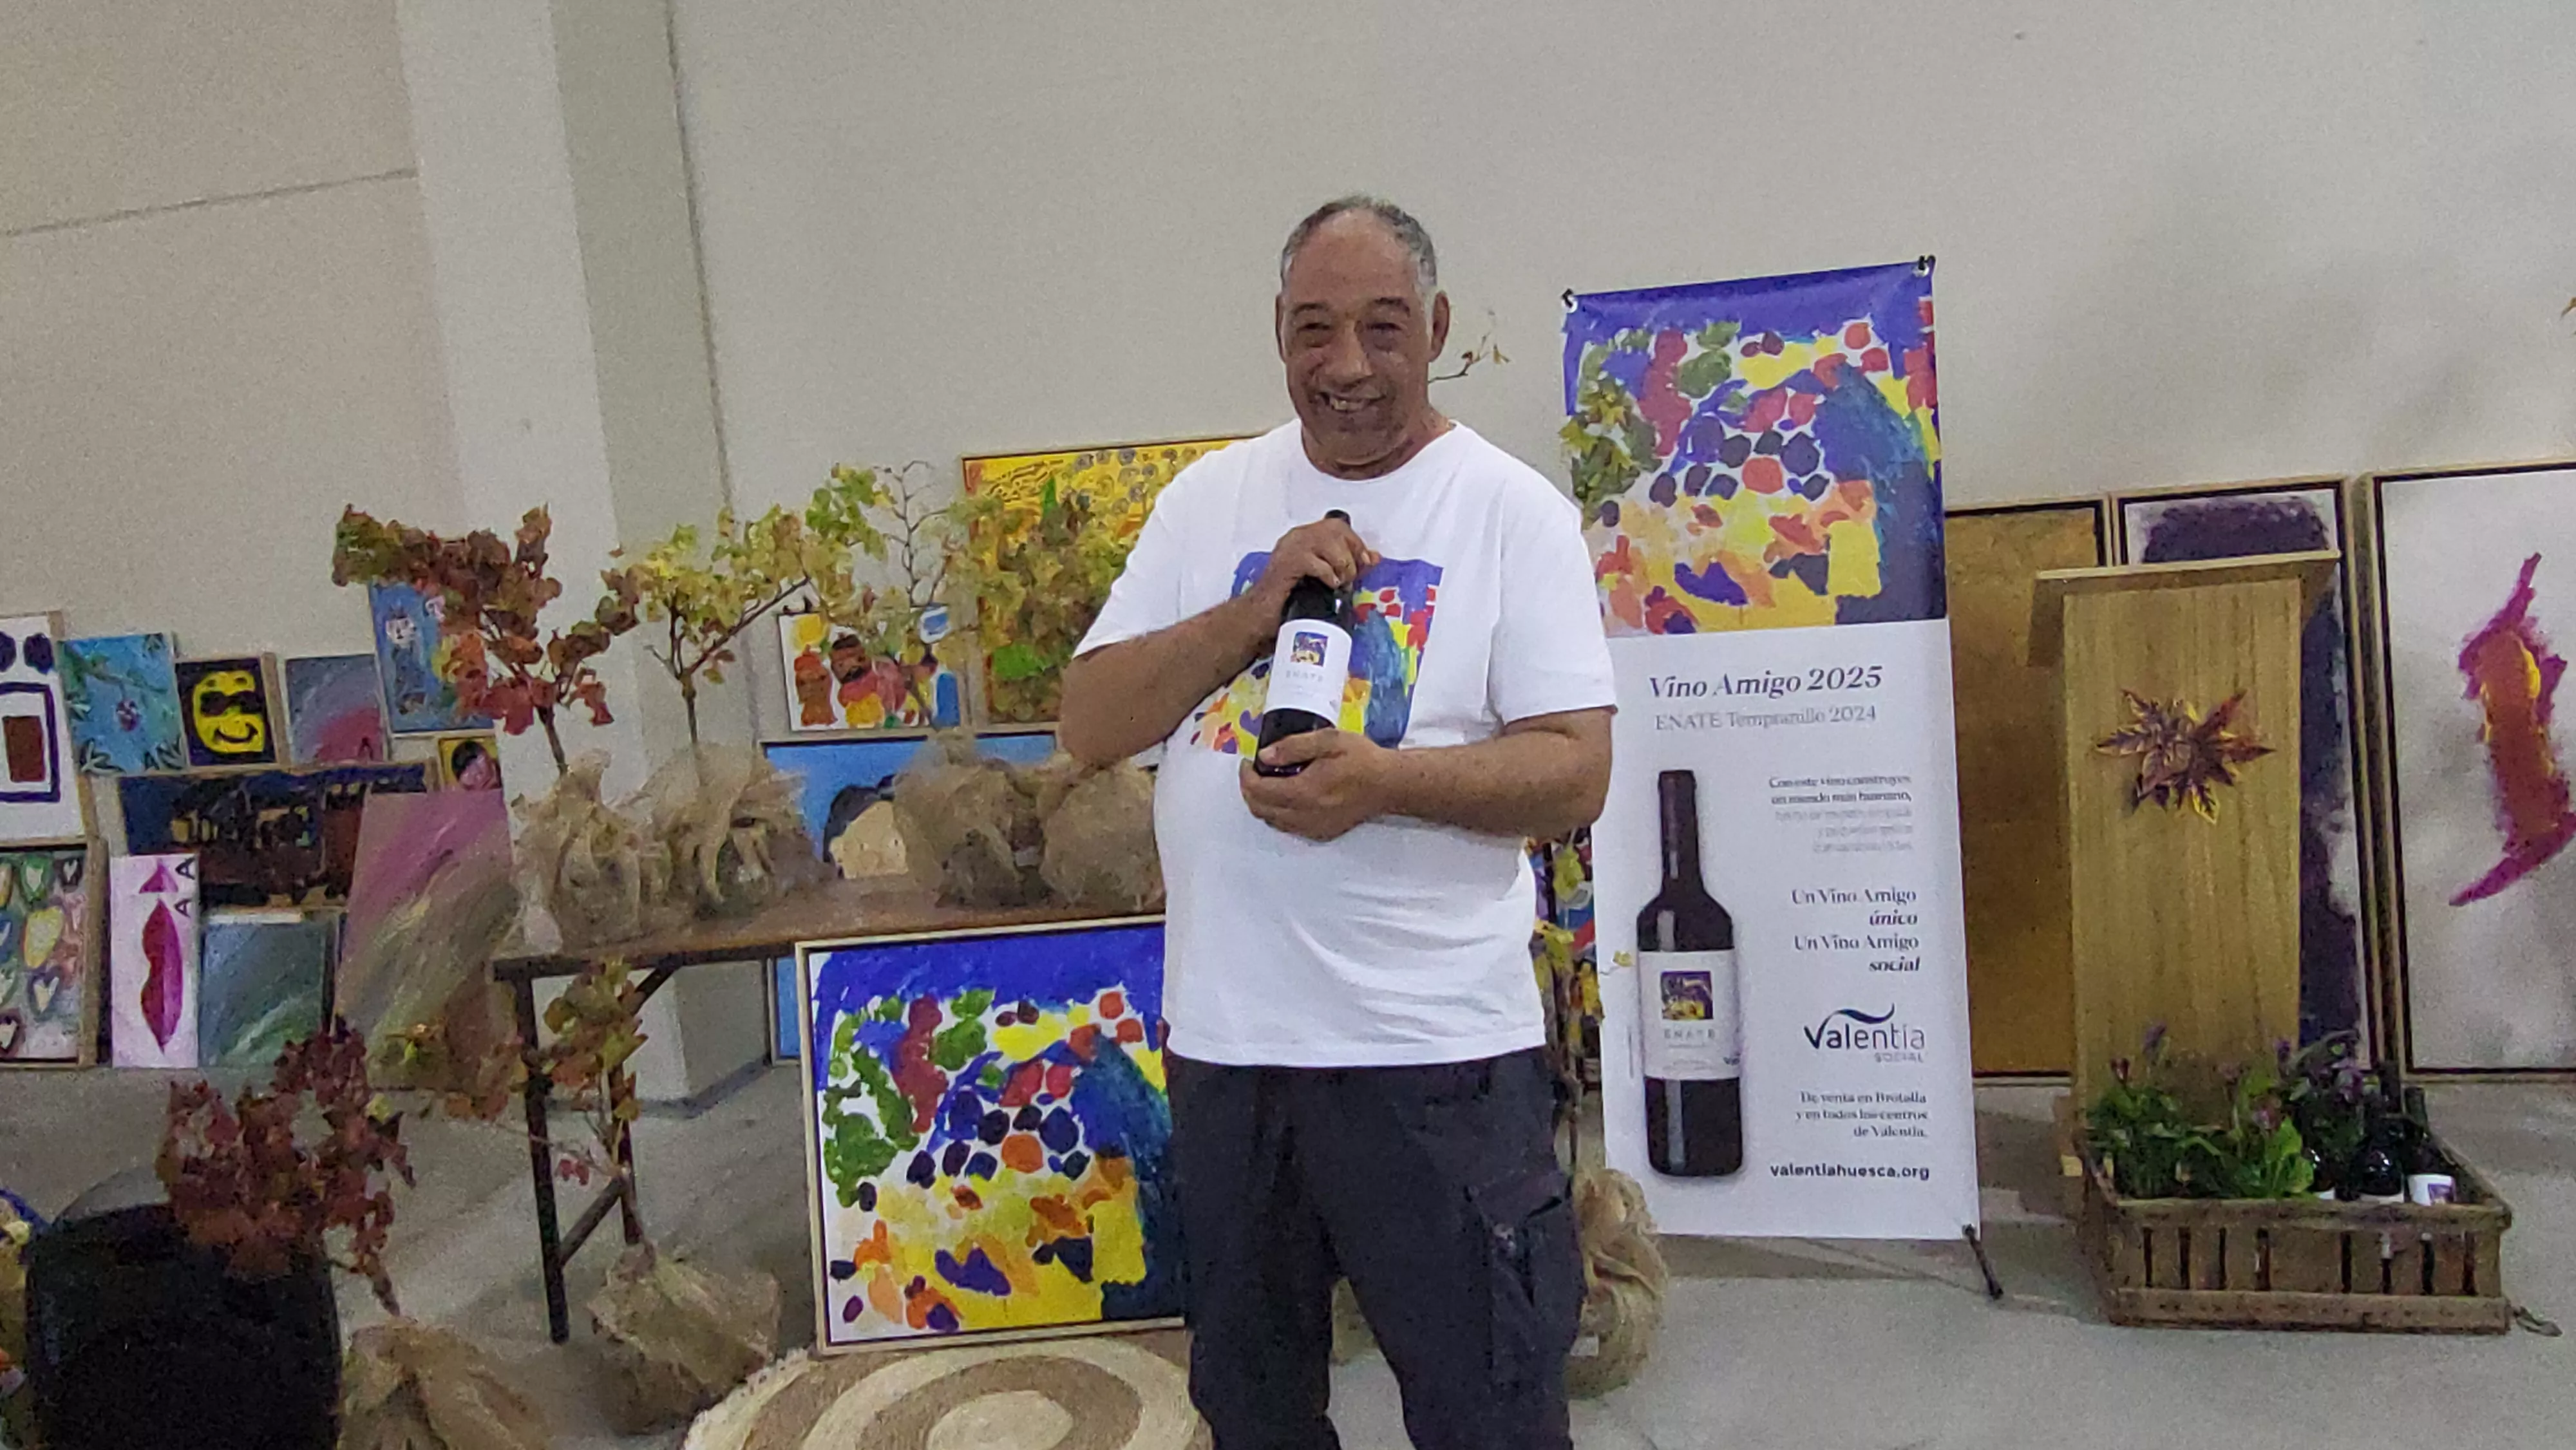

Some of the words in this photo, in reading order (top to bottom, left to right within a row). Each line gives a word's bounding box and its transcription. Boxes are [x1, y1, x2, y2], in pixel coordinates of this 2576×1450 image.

[1649, 675, 1707, 697] Vino
[1712, 670, 1801, 699] Amigo
[1807, 665, 1882, 691] 2025
[1655, 712, 1723, 731] ENATE
[1829, 705, 1877, 722] 2024
[1792, 889, 1815, 905] Un
[1818, 888, 1857, 903] Vino
[1862, 887, 1917, 905] Amigo
[1870, 909, 1918, 926] único
[1794, 935, 1818, 950] Un
[1821, 934, 1860, 950] Vino
[1864, 933, 1919, 951] Amigo
[1869, 956, 1920, 972] social
[1804, 1013, 1925, 1050] Valentia
[1770, 1162, 1929, 1181] valentiahuesca.org
